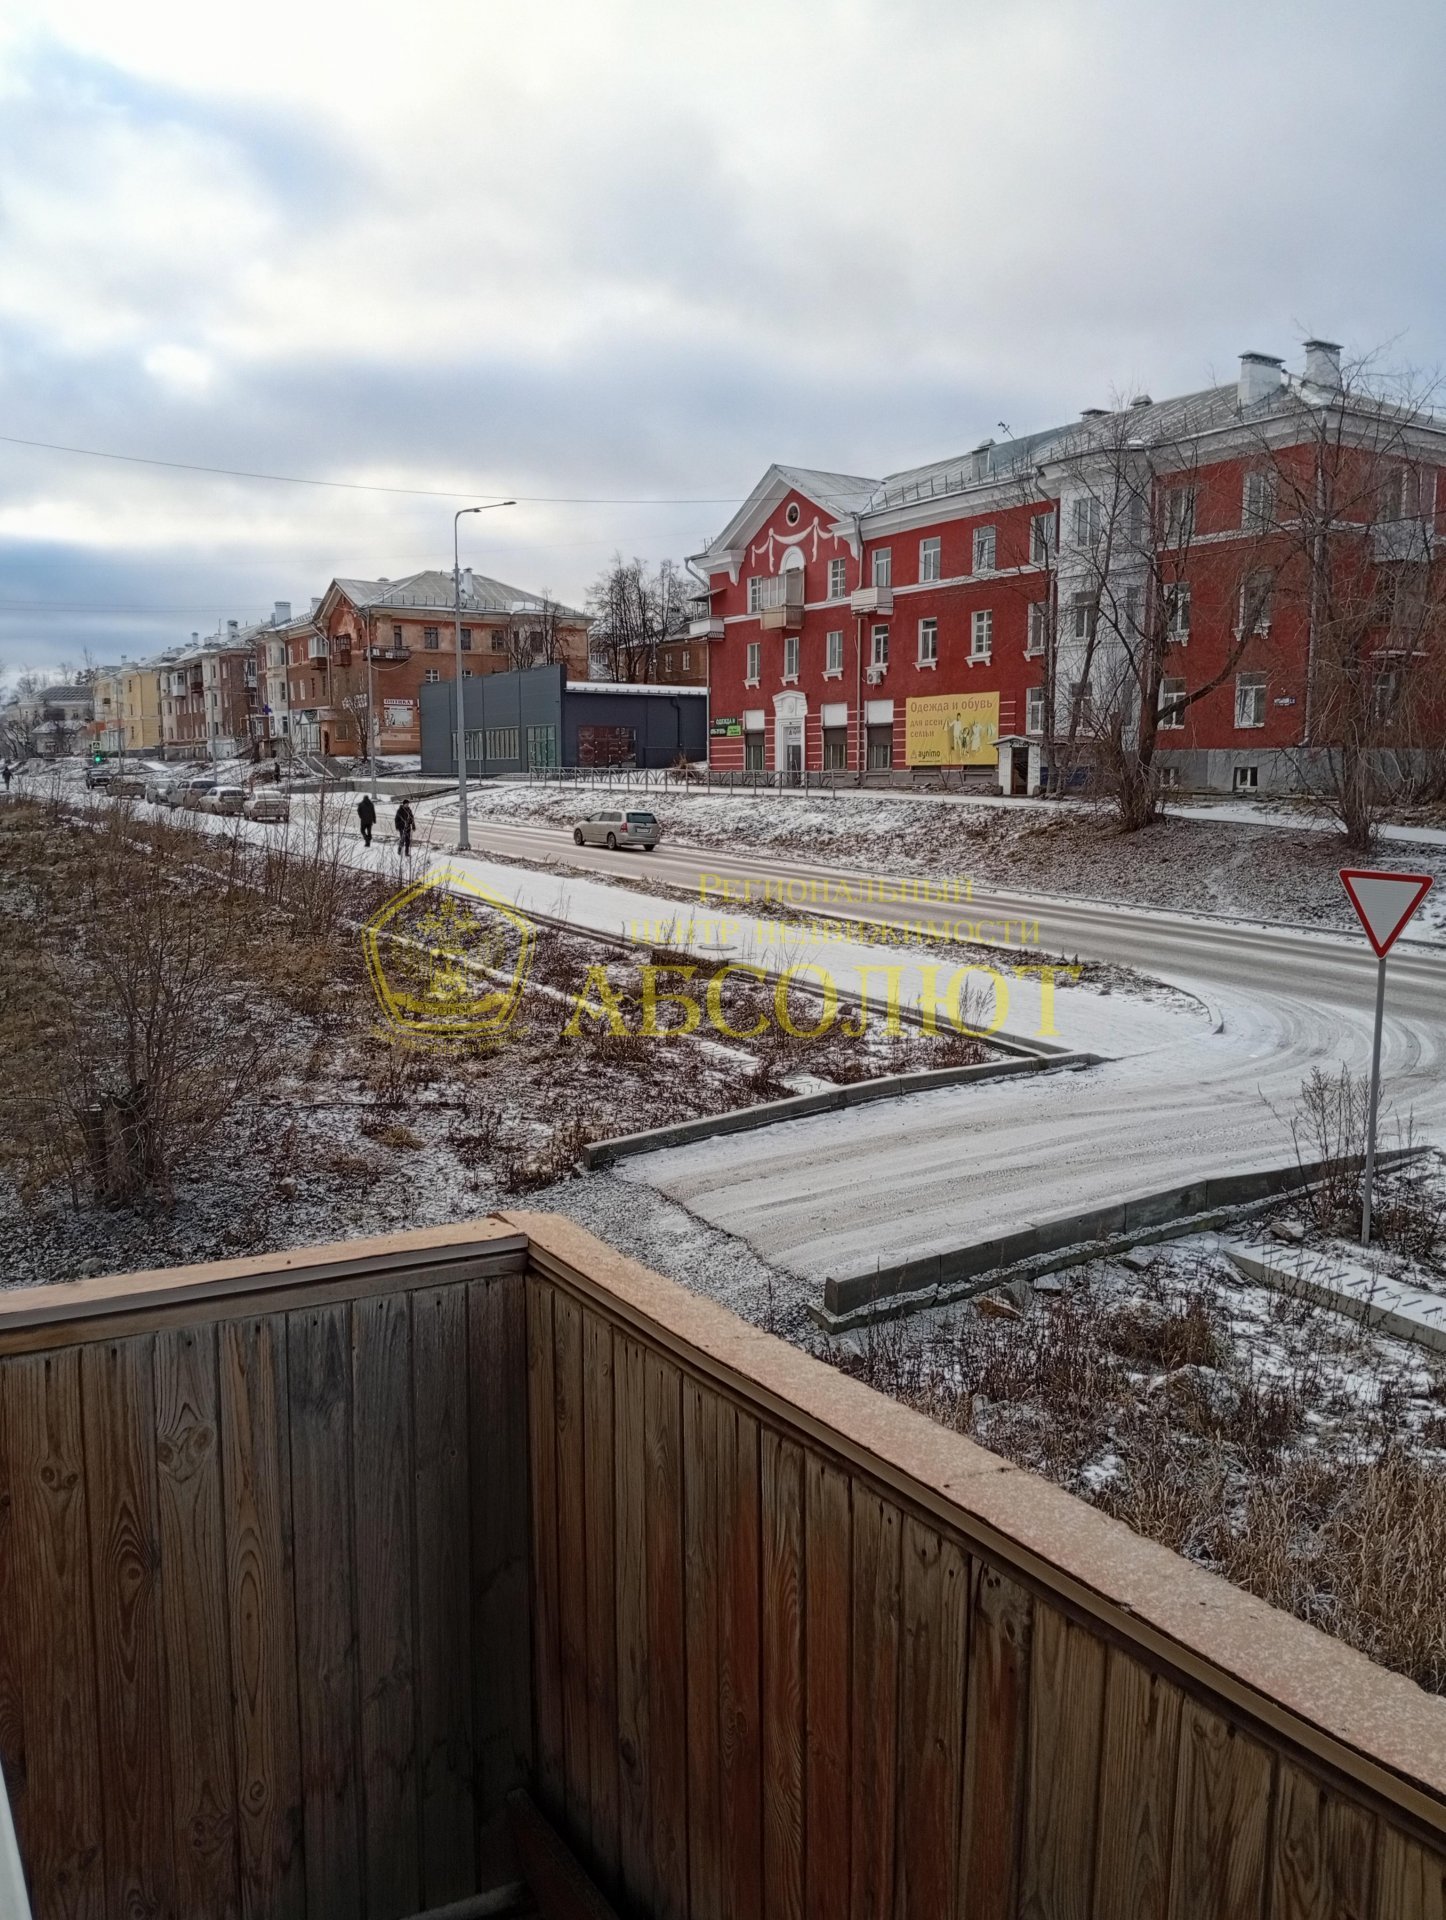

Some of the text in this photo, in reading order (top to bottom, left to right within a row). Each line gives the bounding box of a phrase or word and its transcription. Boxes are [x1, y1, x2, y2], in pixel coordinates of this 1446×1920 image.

[910, 697, 993, 713] Одежда и обувь
